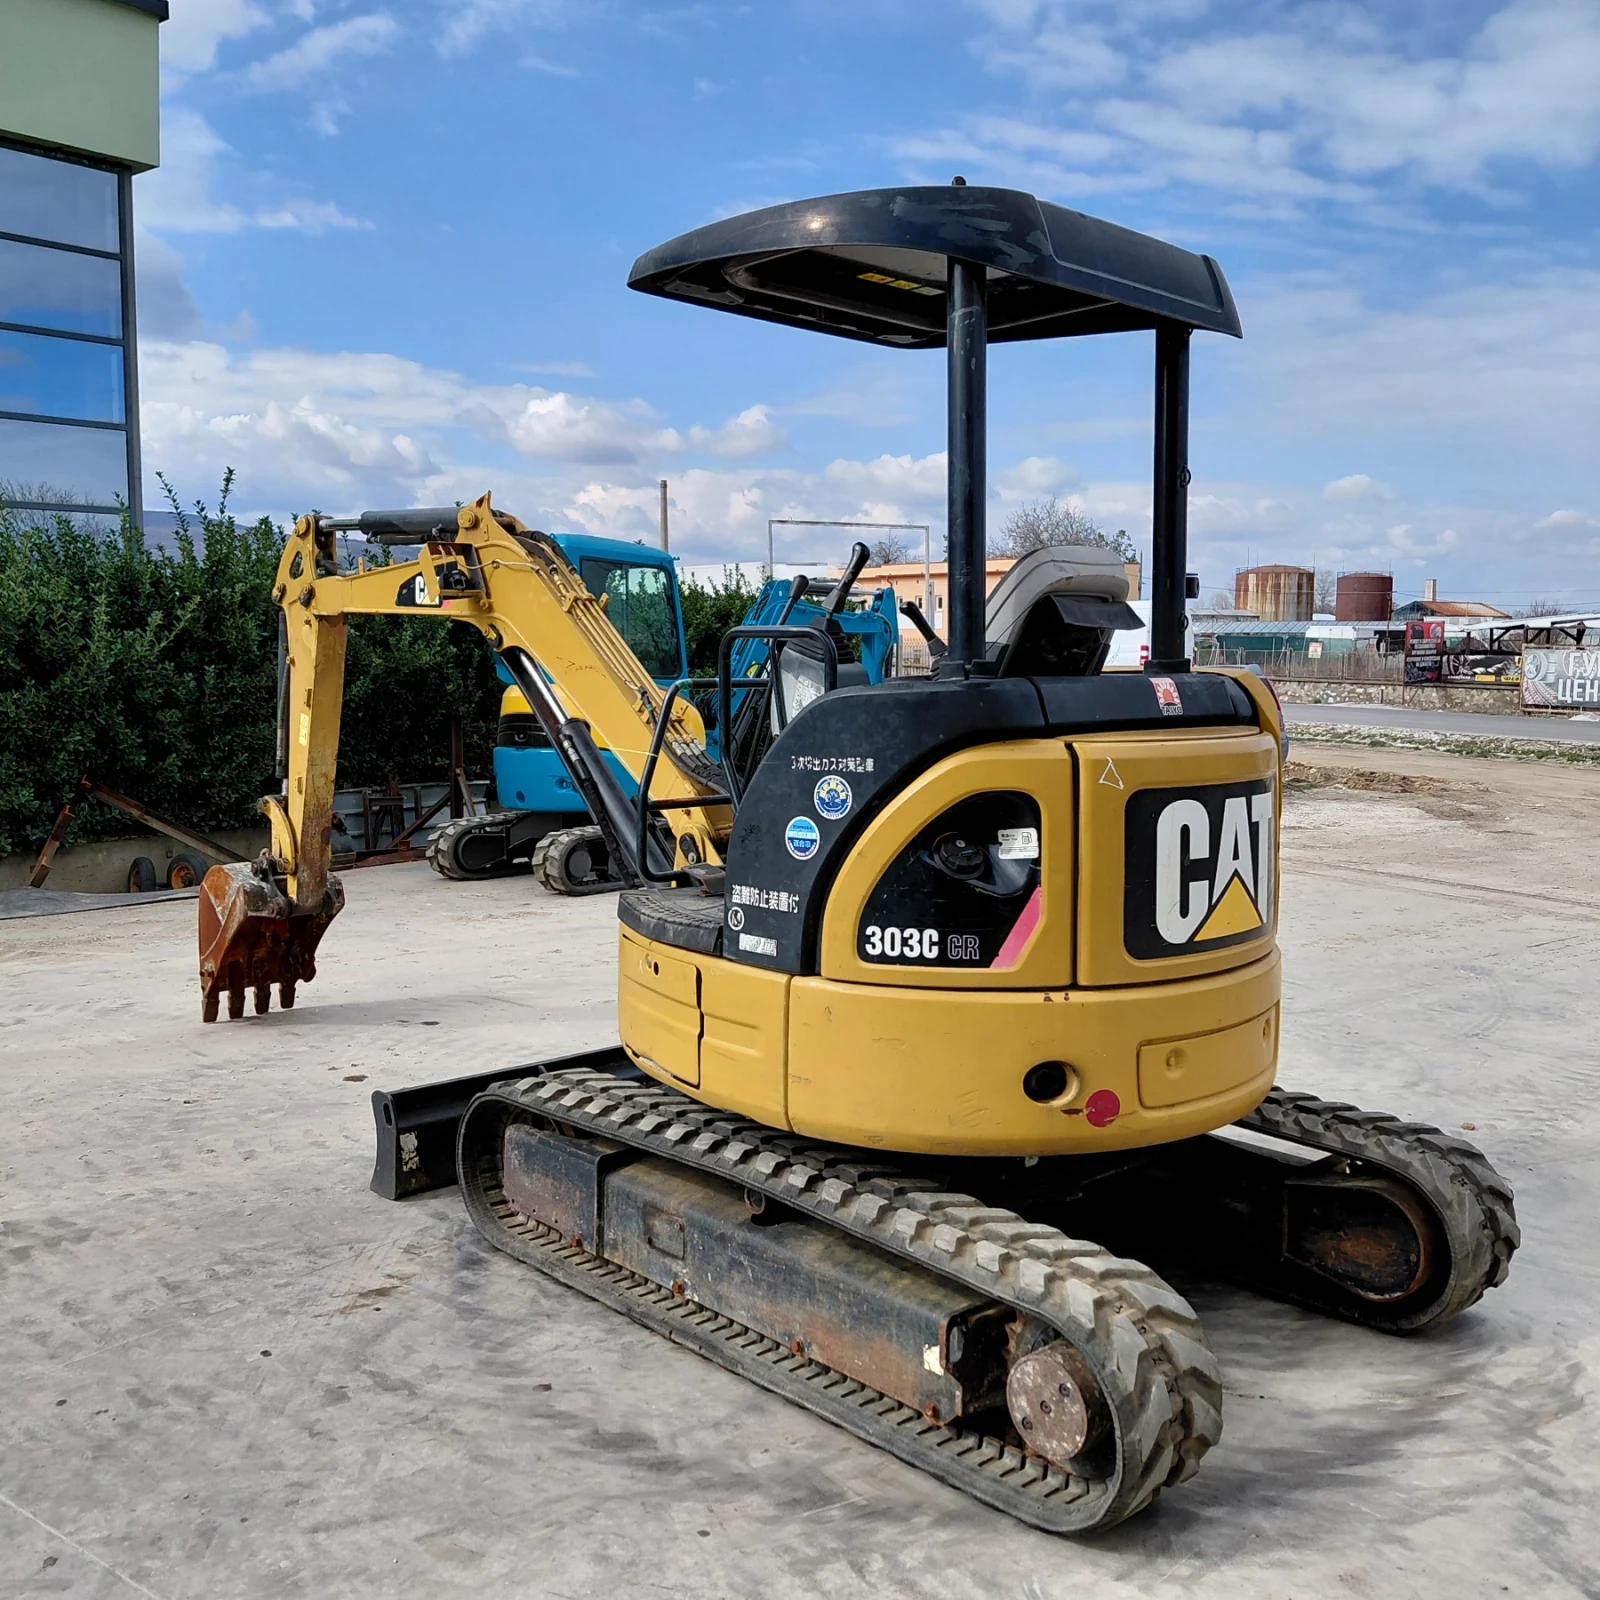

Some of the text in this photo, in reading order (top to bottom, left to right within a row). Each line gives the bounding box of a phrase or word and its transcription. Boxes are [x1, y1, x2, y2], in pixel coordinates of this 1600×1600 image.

[1568, 652, 1600, 679] ГУ
[1156, 792, 1272, 944] CAT
[865, 925, 980, 960] 303C CR
